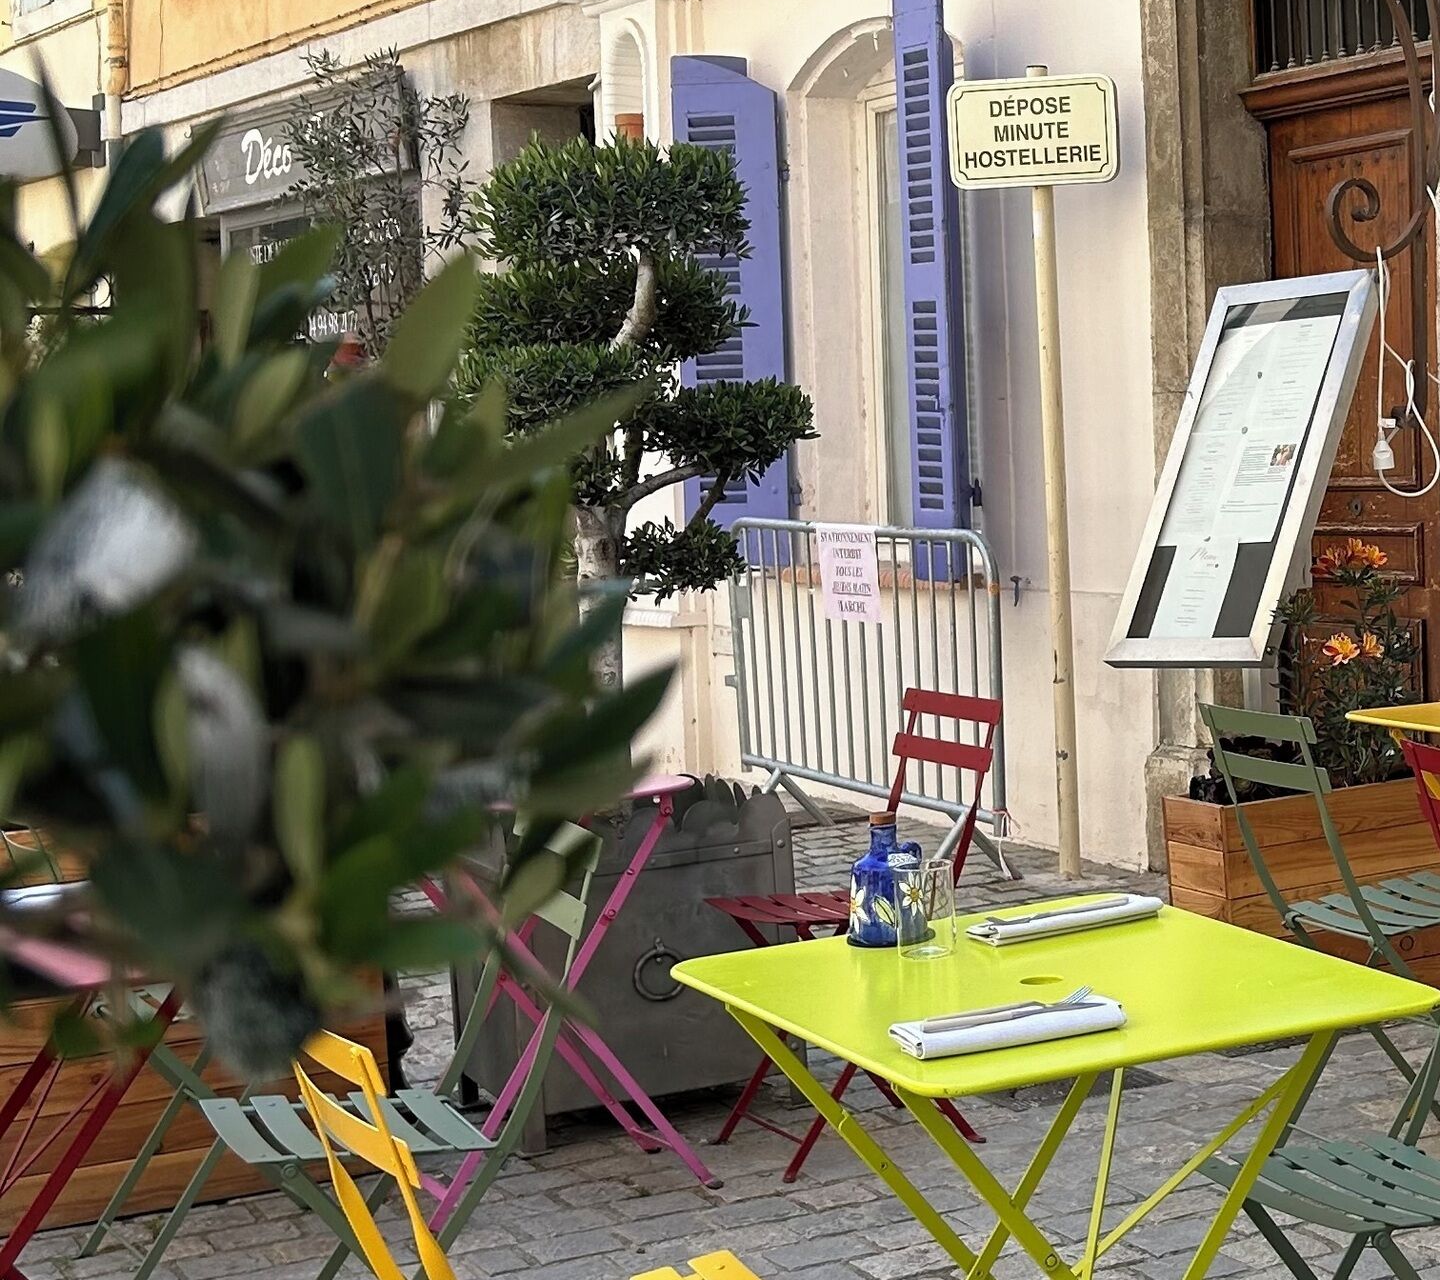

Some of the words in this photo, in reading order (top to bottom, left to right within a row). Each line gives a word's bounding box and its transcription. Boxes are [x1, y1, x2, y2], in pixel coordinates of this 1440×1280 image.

[989, 95, 1071, 118] DÉPOSE
[994, 121, 1069, 142] MINUTE
[241, 128, 292, 185] Déco
[965, 144, 1101, 169] HOSTELLERIE
[820, 531, 873, 543] STATIONNEMENT
